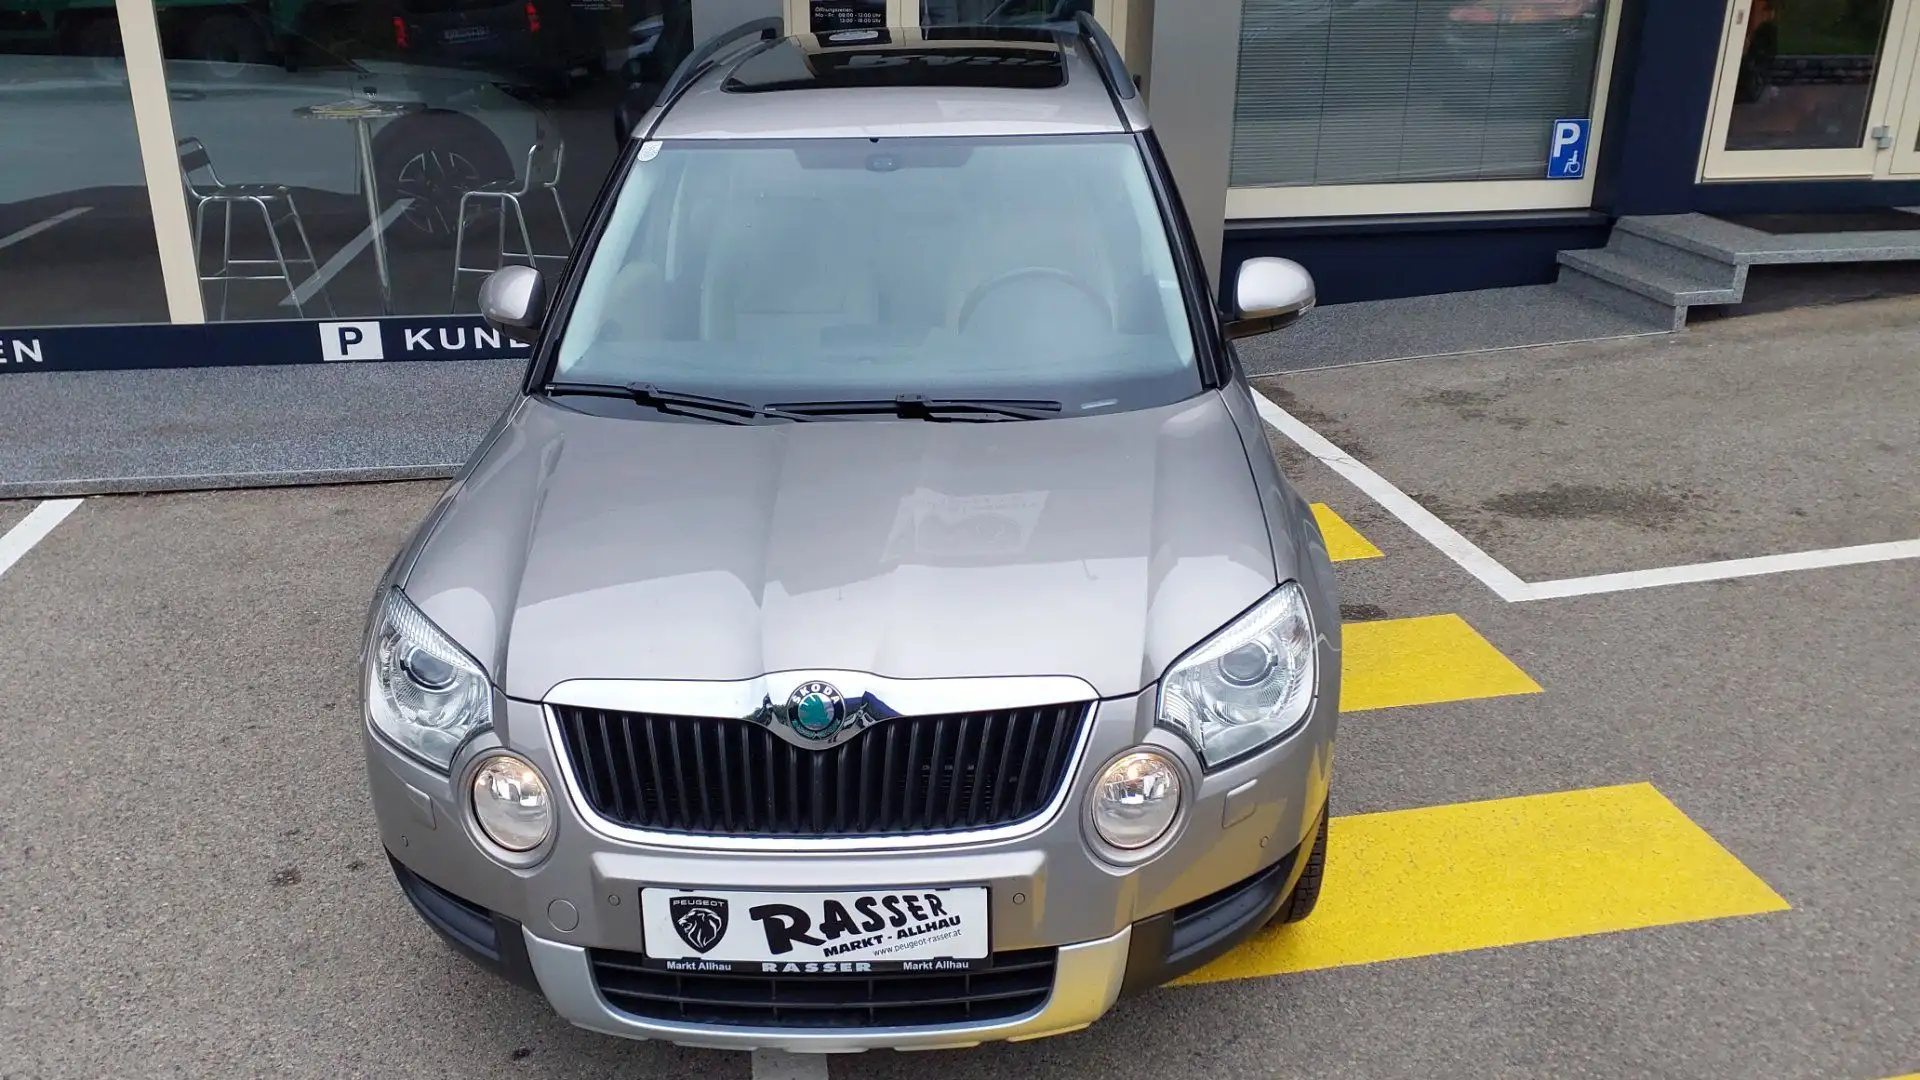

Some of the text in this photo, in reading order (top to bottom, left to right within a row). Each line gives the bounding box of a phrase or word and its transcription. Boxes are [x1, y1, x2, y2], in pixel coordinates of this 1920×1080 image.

[1553, 122, 1580, 158] P
[338, 326, 363, 356] P
[672, 899, 725, 907] PEUGEOT
[749, 893, 948, 955] RASSER
[823, 934, 884, 957] MARKT
[896, 915, 961, 940] ALLHAU
[873, 928, 962, 957] www.peugeot-rasser.at
[666, 960, 732, 971] Markt Allhau
[762, 962, 872, 972] RASSER
[903, 960, 969, 970] Markt Allhau
